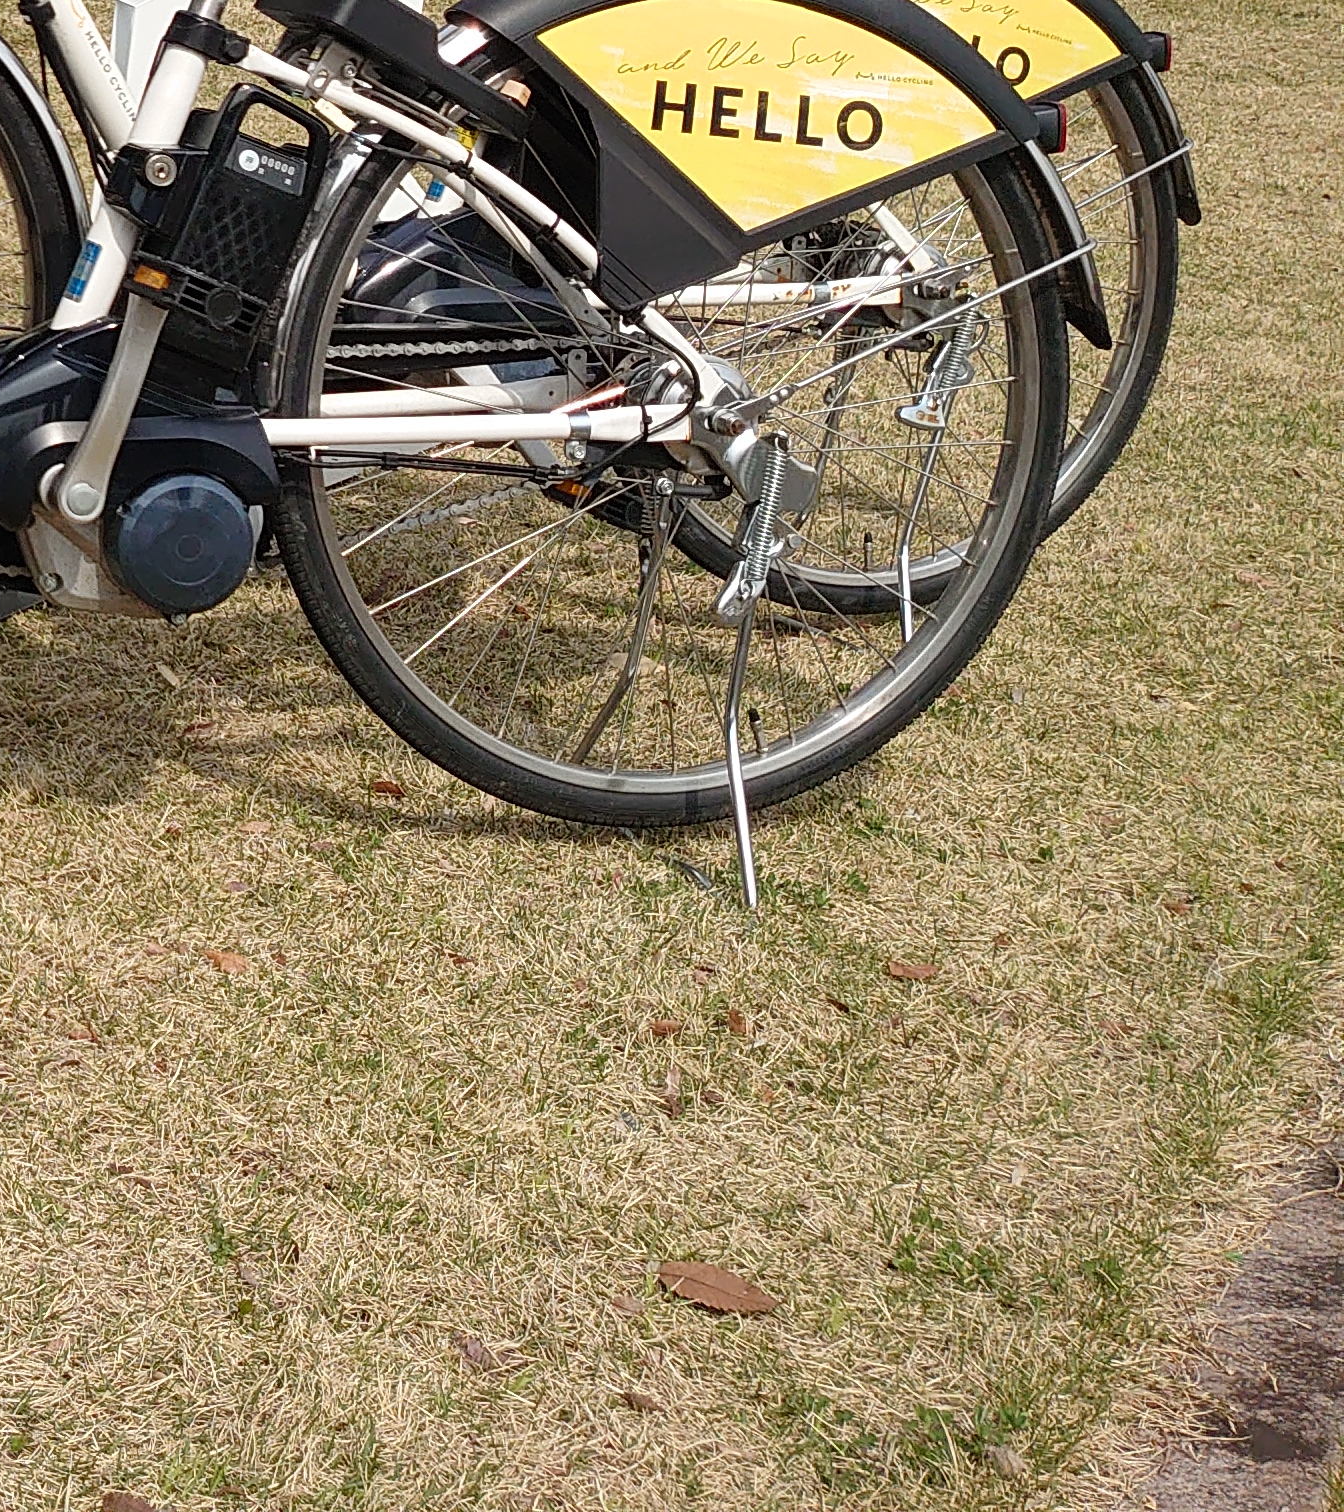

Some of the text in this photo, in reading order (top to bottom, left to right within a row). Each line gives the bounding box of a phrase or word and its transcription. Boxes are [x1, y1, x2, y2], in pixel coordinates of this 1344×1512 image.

[84, 30, 138, 123] HELLO CYCLIN
[617, 35, 855, 77] and We Say
[877, 74, 934, 86] HELLO CYCLING
[650, 80, 884, 152] HELLO
